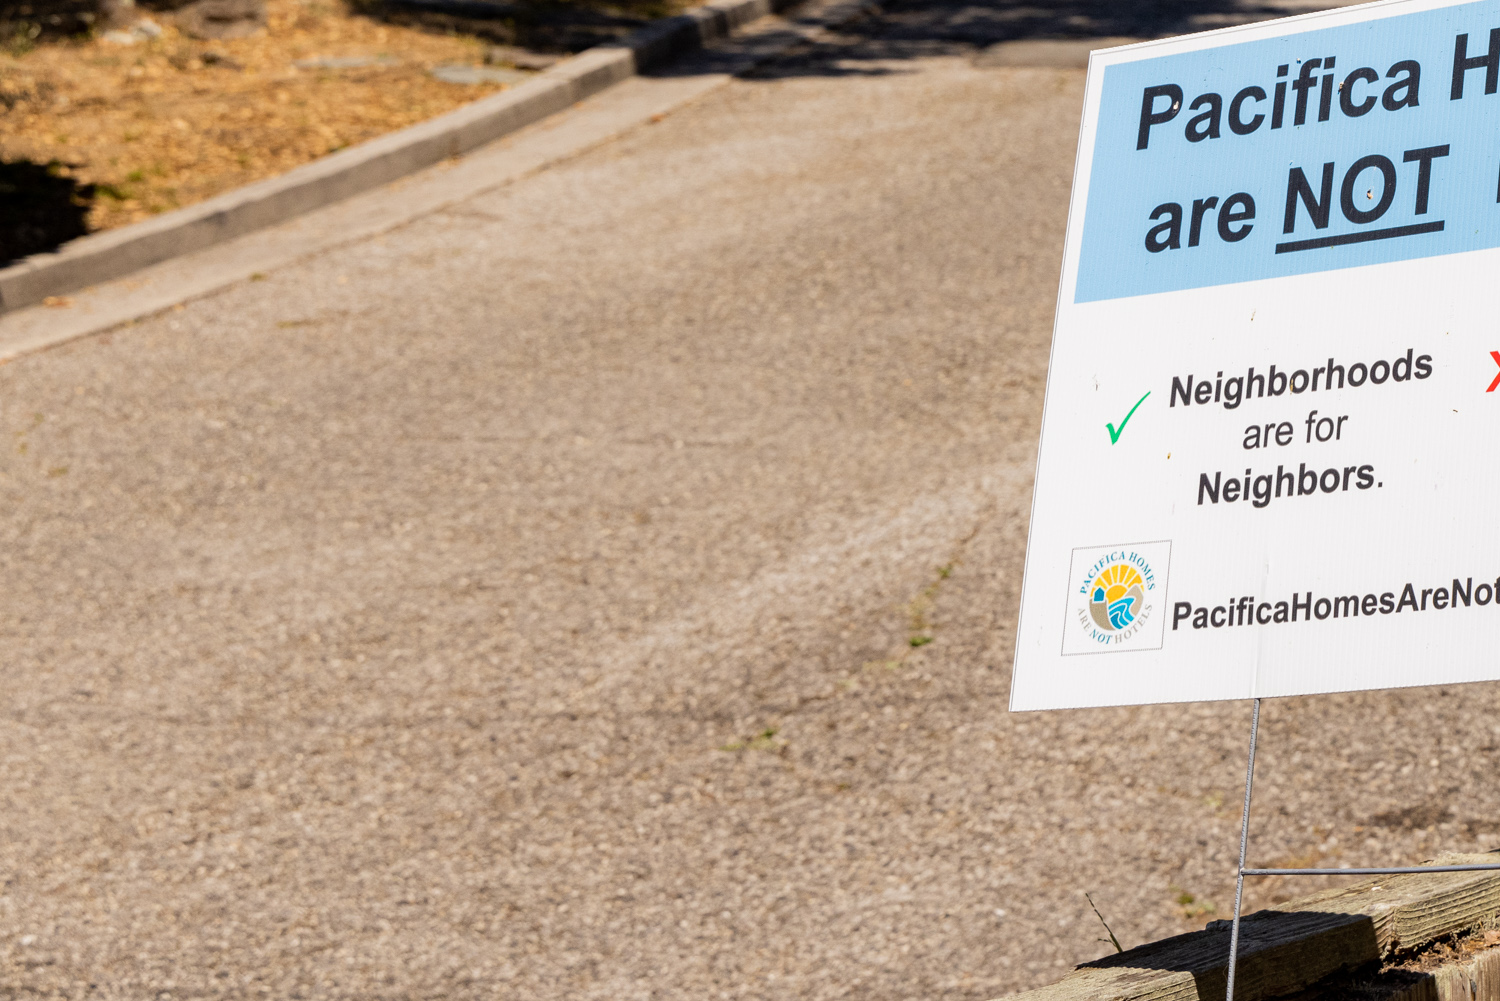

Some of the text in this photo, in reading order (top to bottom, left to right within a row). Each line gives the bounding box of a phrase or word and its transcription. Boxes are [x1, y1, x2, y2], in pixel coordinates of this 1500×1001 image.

[1136, 56, 1422, 151] Pacifica
[1145, 192, 1256, 254] are
[1281, 144, 1451, 235] NOT
[1169, 348, 1433, 409] Neighborhoods
[1242, 410, 1349, 450] are for
[1197, 463, 1385, 508] Neighbors.
[1080, 551, 1156, 594] PACIFICA HOMES
[1078, 603, 1153, 645] ARE NOT HOTELS
